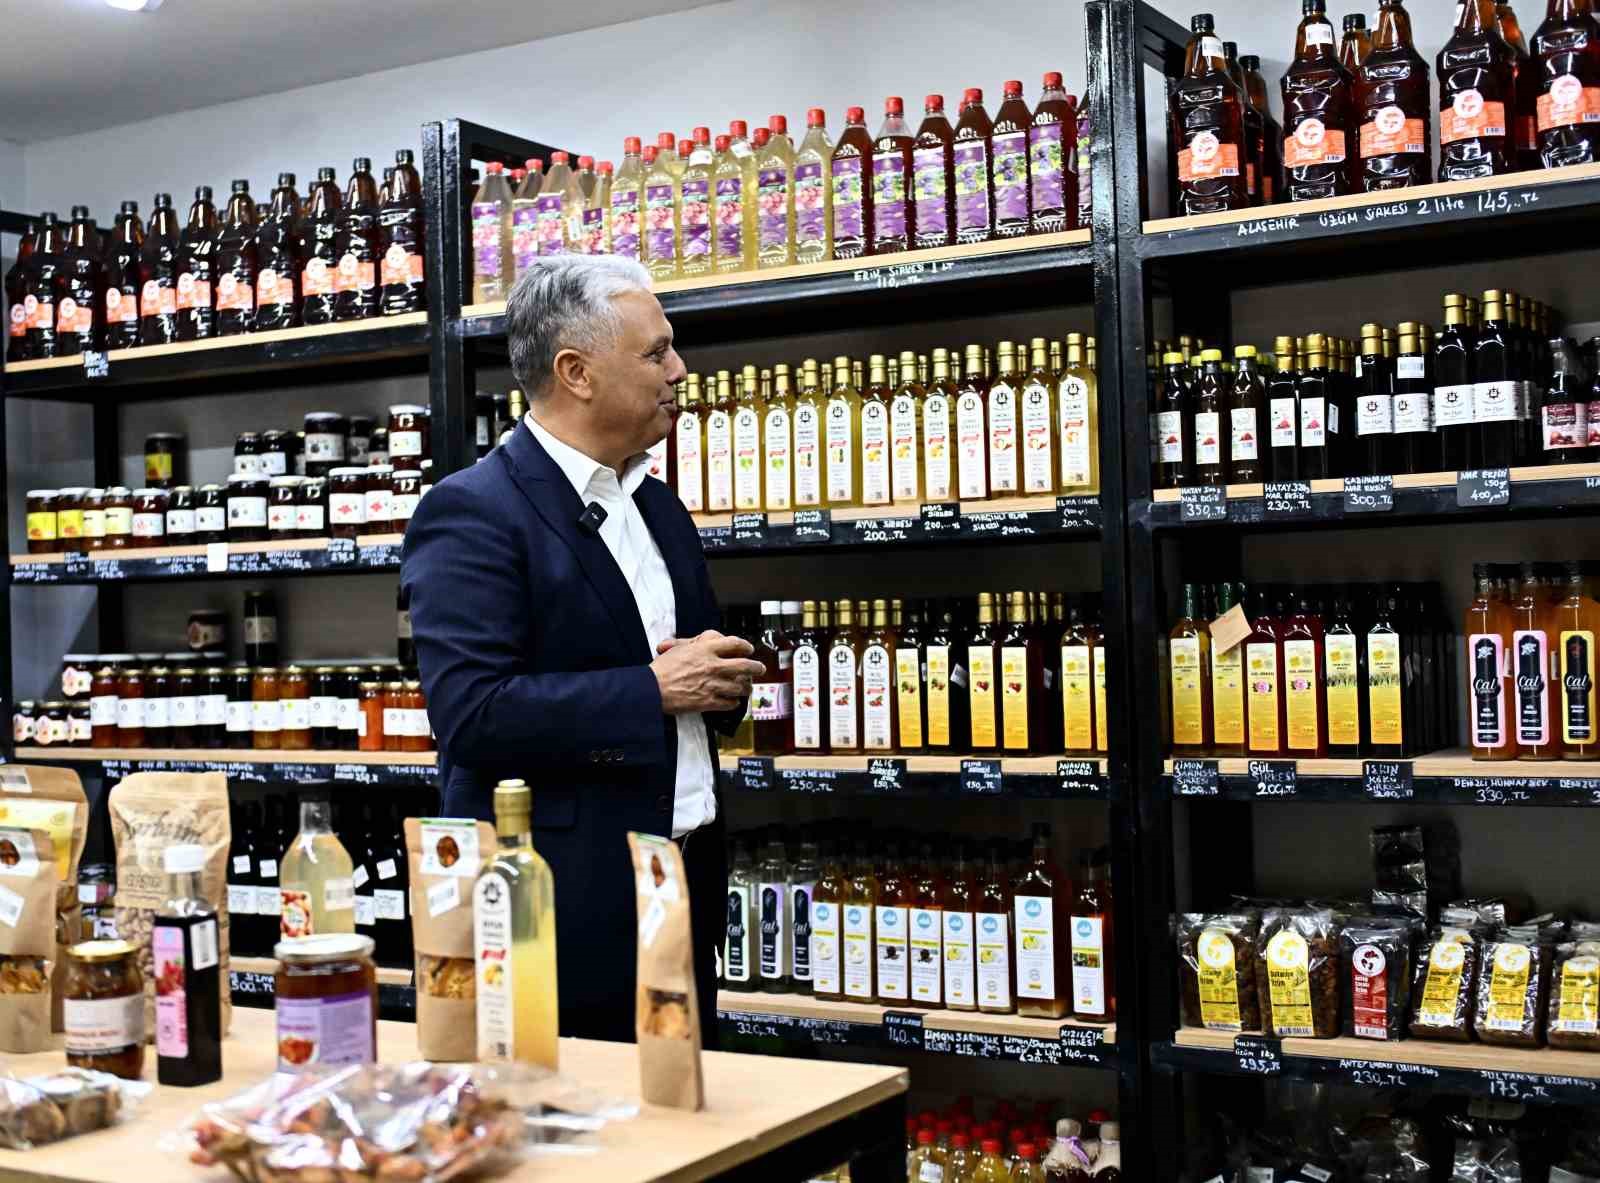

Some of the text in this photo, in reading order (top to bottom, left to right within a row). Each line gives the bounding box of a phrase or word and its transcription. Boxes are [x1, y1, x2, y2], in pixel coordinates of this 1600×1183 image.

[1417, 199, 1430, 214] 2
[1435, 196, 1465, 213] litre
[856, 520, 879, 530] AYVA
[1475, 678, 1497, 690] Cal
[1519, 675, 1540, 687] Cal
[1566, 675, 1587, 687] Cal
[1250, 761, 1274, 774] GÜL
